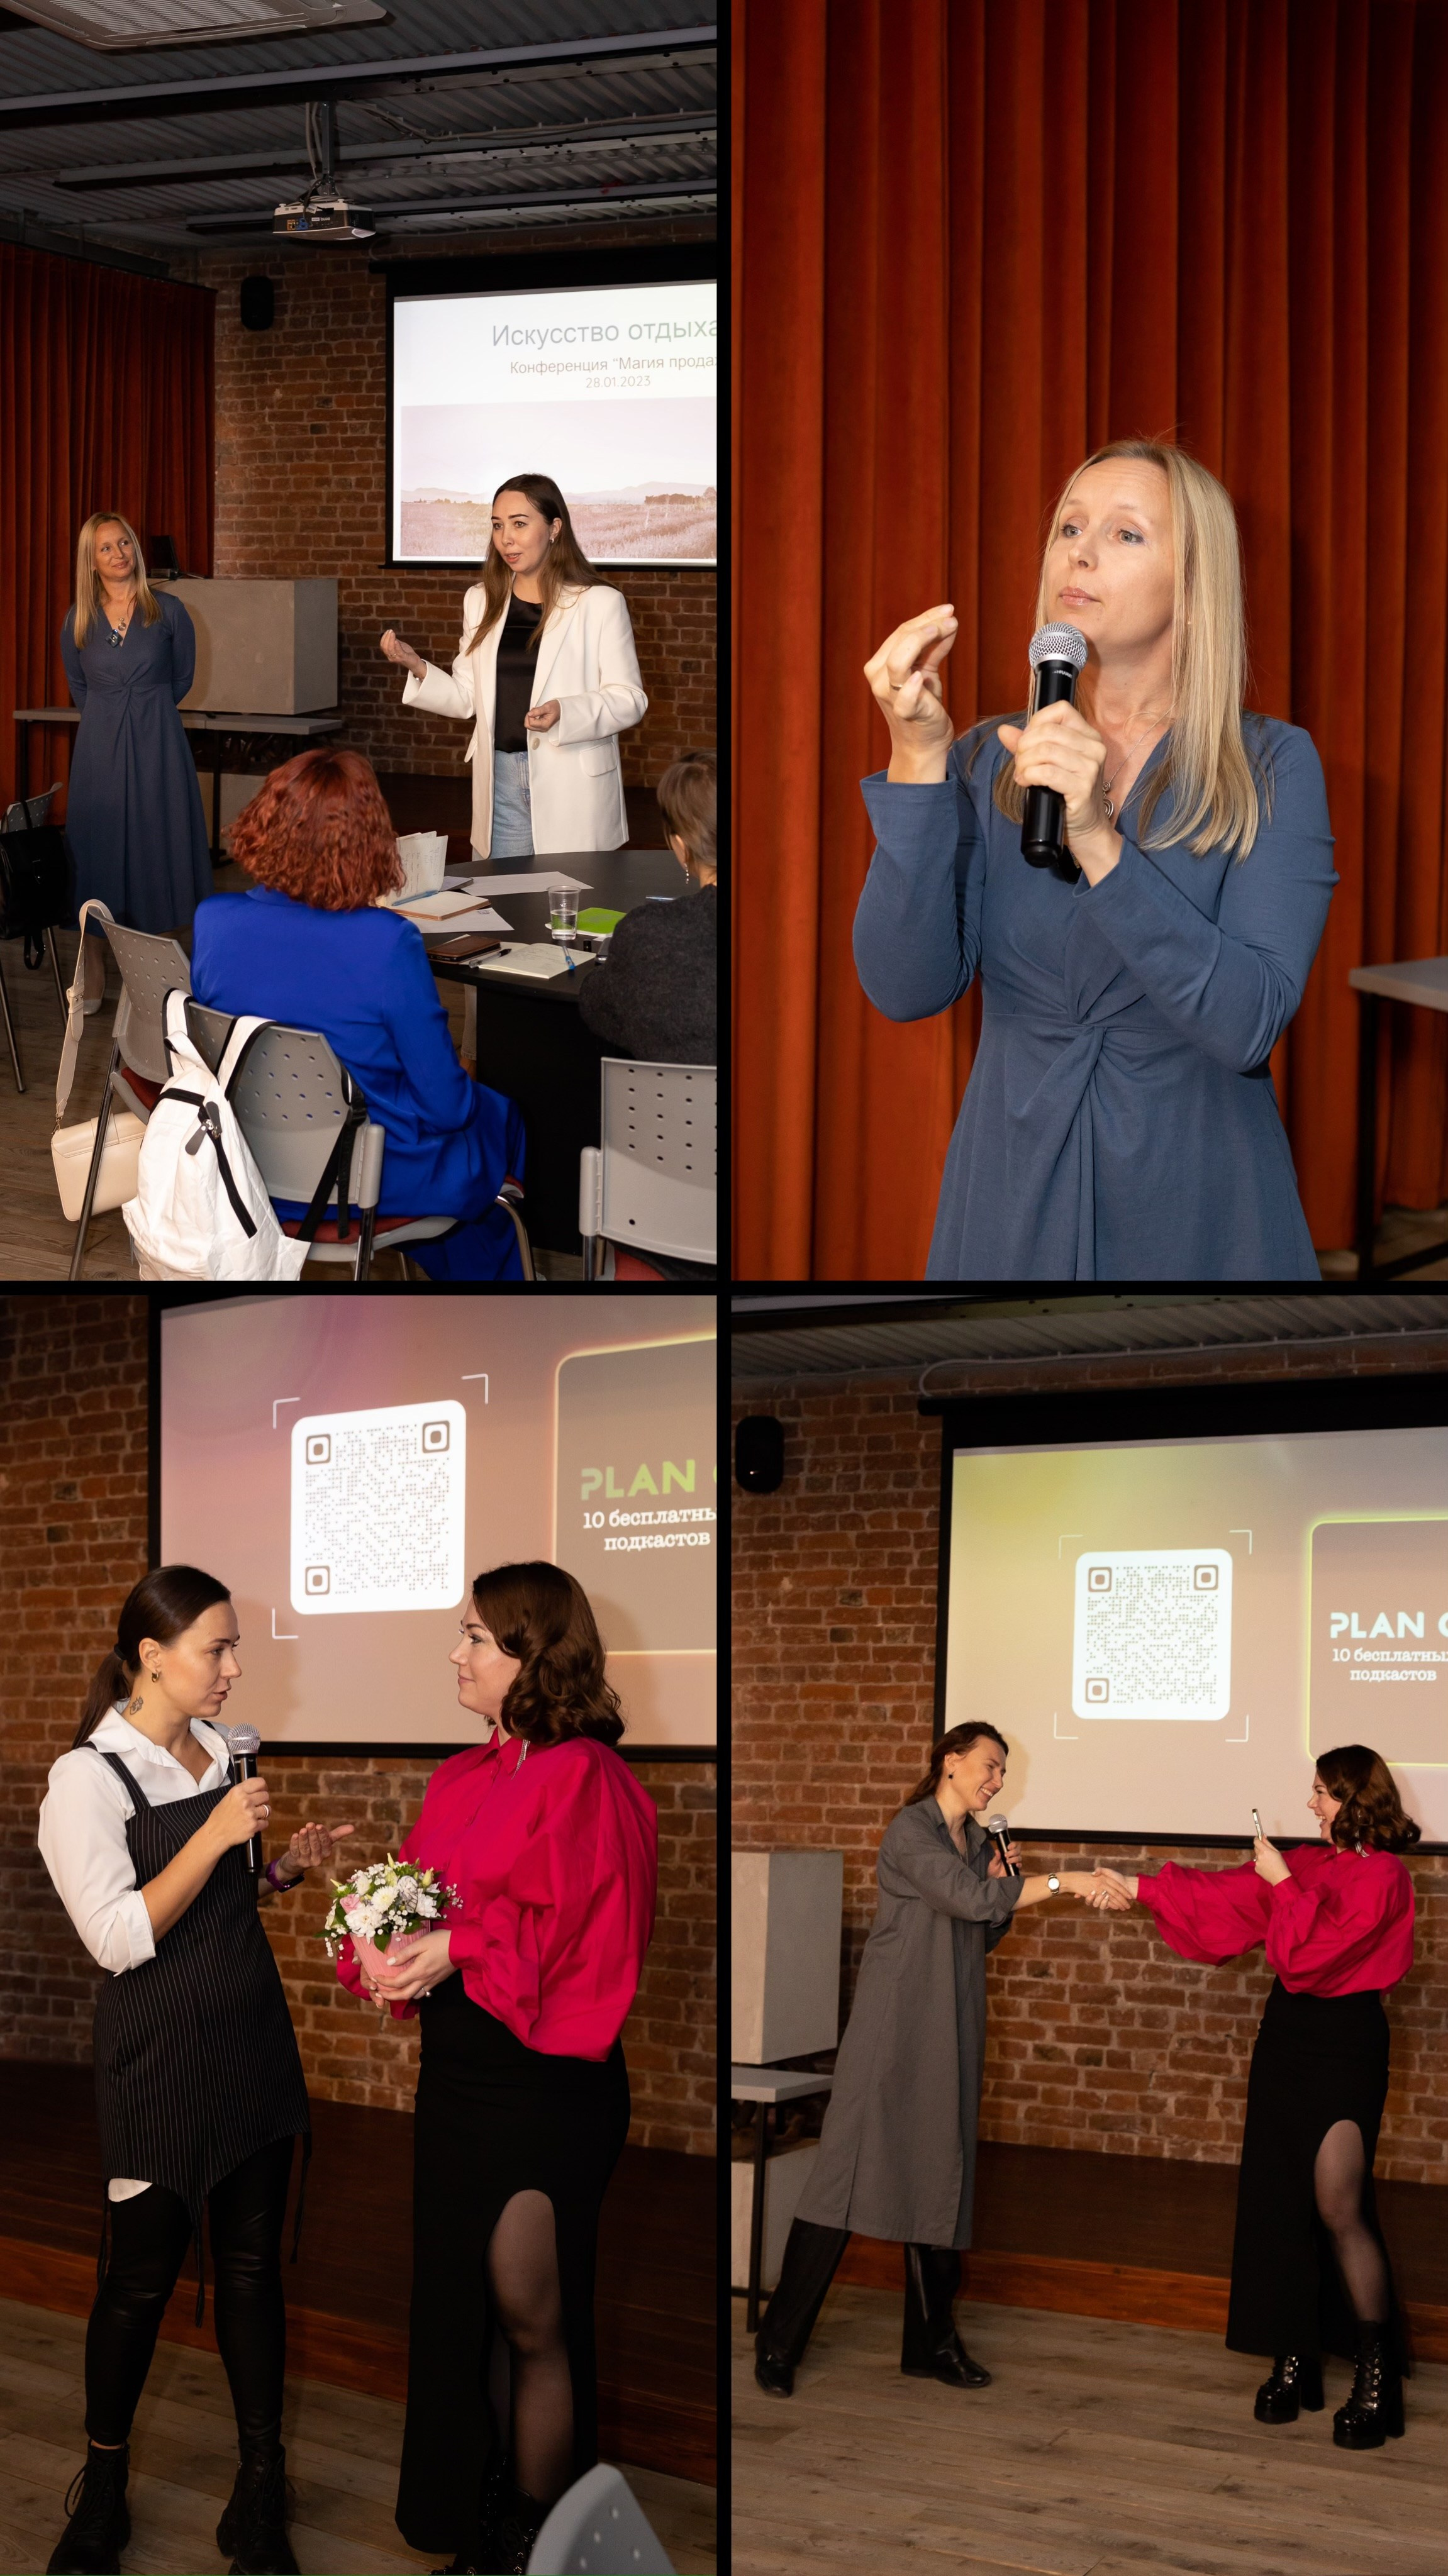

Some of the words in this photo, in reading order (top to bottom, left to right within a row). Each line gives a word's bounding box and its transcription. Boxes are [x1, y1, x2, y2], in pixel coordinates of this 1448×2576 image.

[493, 325, 620, 350] Искусство
[628, 319, 716, 343] отдыха
[510, 360, 608, 376] Конференция
[669, 356, 716, 371] прода
[585, 375, 652, 389] 28.01.2023
[581, 1458, 696, 1501] PLAN
[582, 1511, 605, 1529] 10
[603, 1532, 711, 1552] подкастов
[1330, 1611, 1425, 1638] PLAN
[1332, 1648, 1351, 1662] 10
[1353, 1647, 1448, 1662] бесплатны
[1349, 1669, 1437, 1682] подкастов
